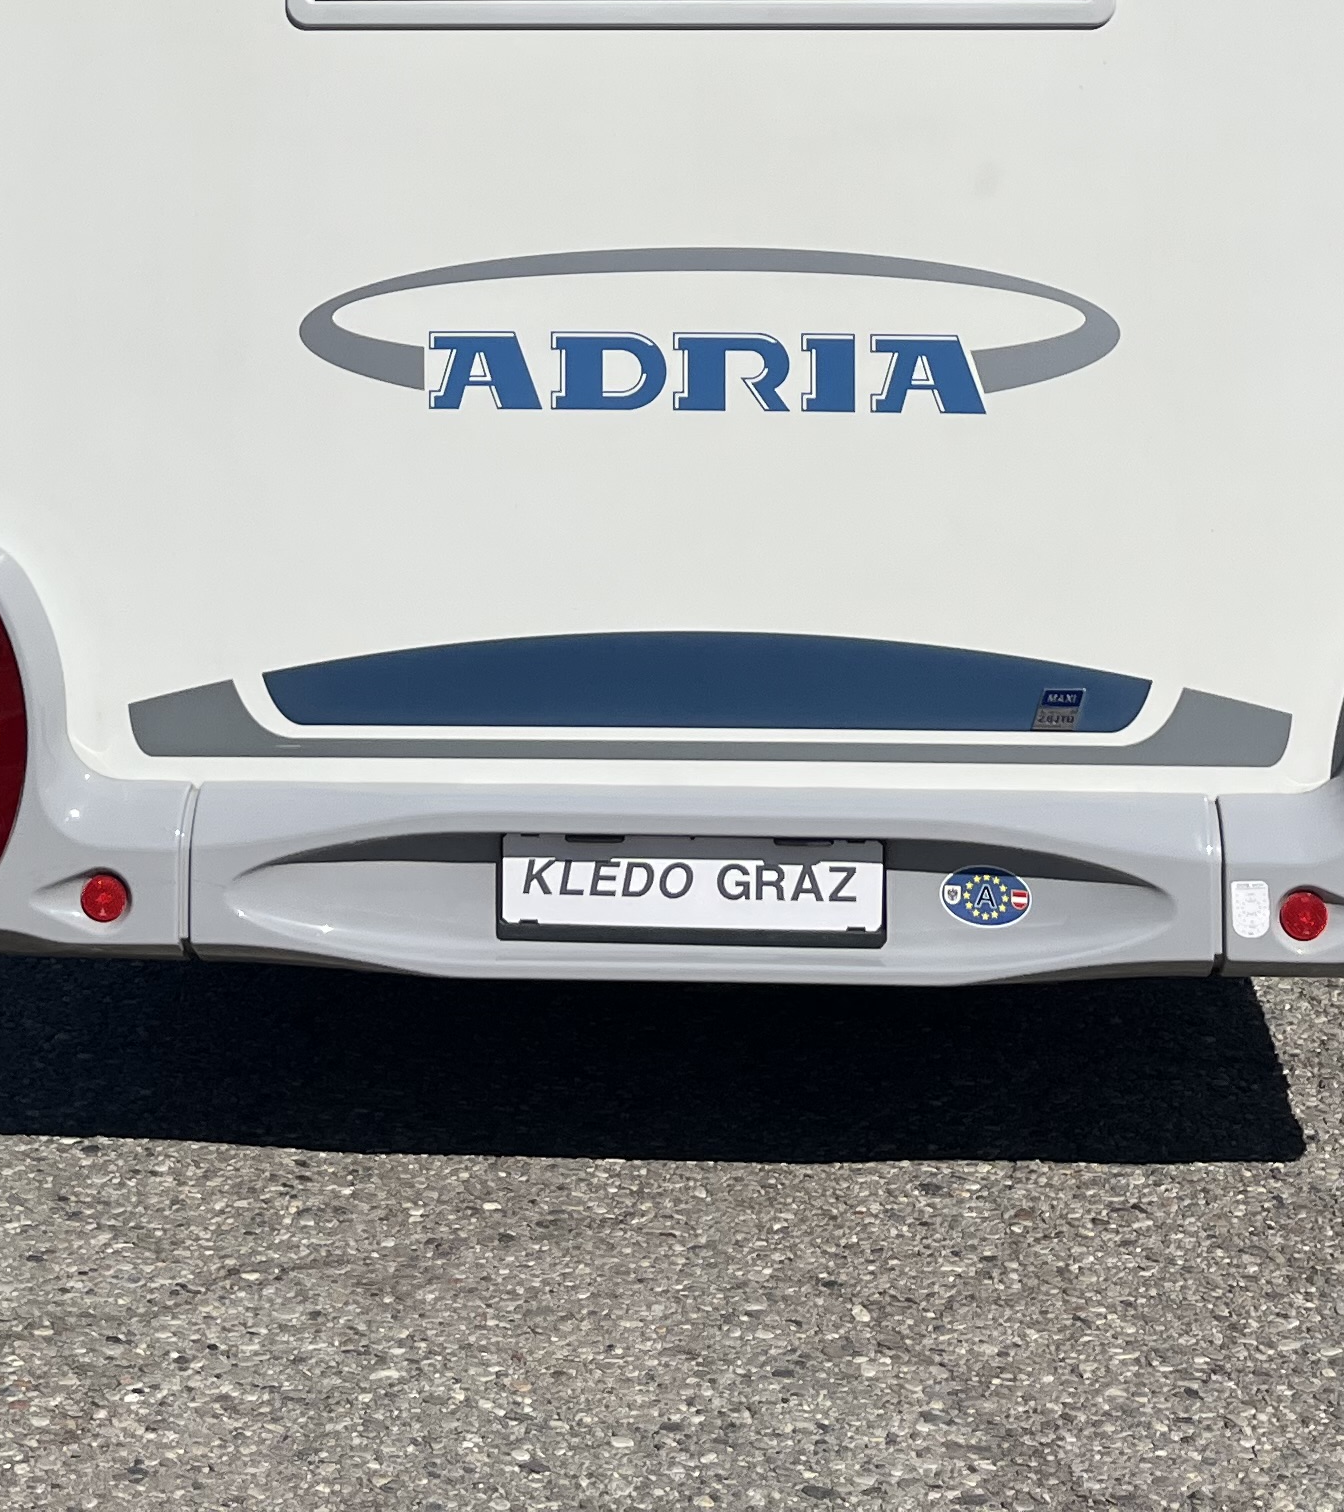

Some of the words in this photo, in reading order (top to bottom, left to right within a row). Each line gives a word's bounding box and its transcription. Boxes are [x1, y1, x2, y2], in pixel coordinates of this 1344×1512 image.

[428, 331, 987, 414] ADRIA
[523, 858, 693, 899] KLEDO
[717, 862, 858, 903] GRAZ
[974, 882, 997, 910] A
